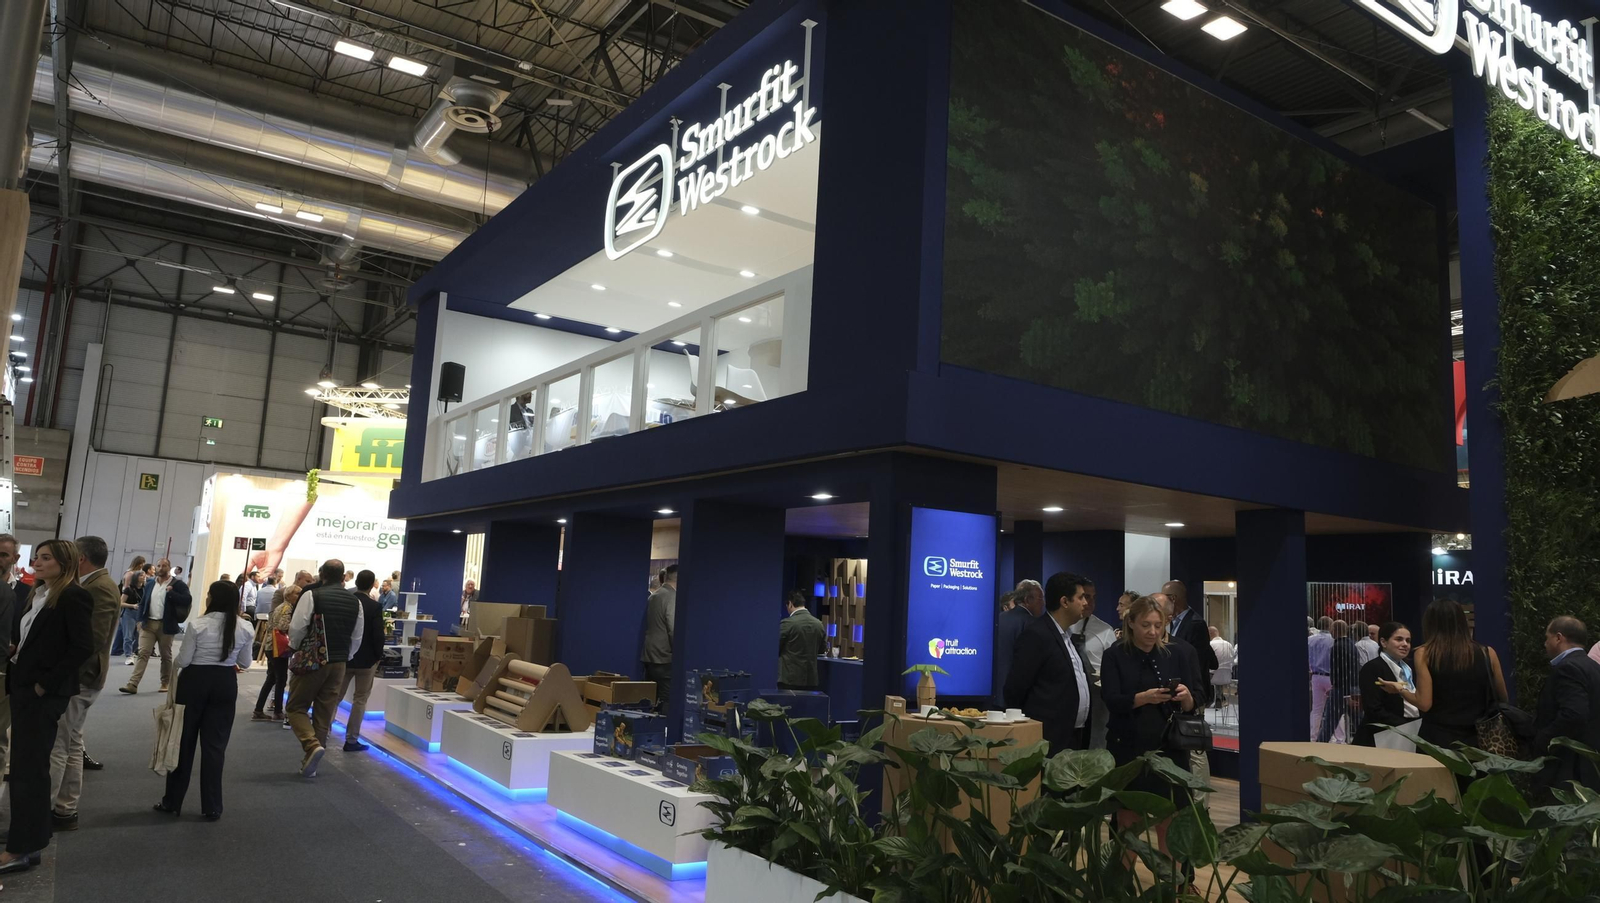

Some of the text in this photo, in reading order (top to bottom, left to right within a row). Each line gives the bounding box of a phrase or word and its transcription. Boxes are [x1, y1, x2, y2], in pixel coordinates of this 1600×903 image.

[1466, 0, 1594, 91] murfit
[680, 59, 799, 172] Smurfit
[678, 100, 818, 217] Westrock
[355, 428, 406, 468] fit
[316, 515, 378, 532] mejorar
[344, 534, 376, 542] nuestros
[950, 558, 980, 570] Smurfit
[950, 568, 984, 579] Westrock
[1432, 568, 1474, 585] iRA
[944, 646, 978, 655] attraction
[946, 638, 959, 646] fruit
